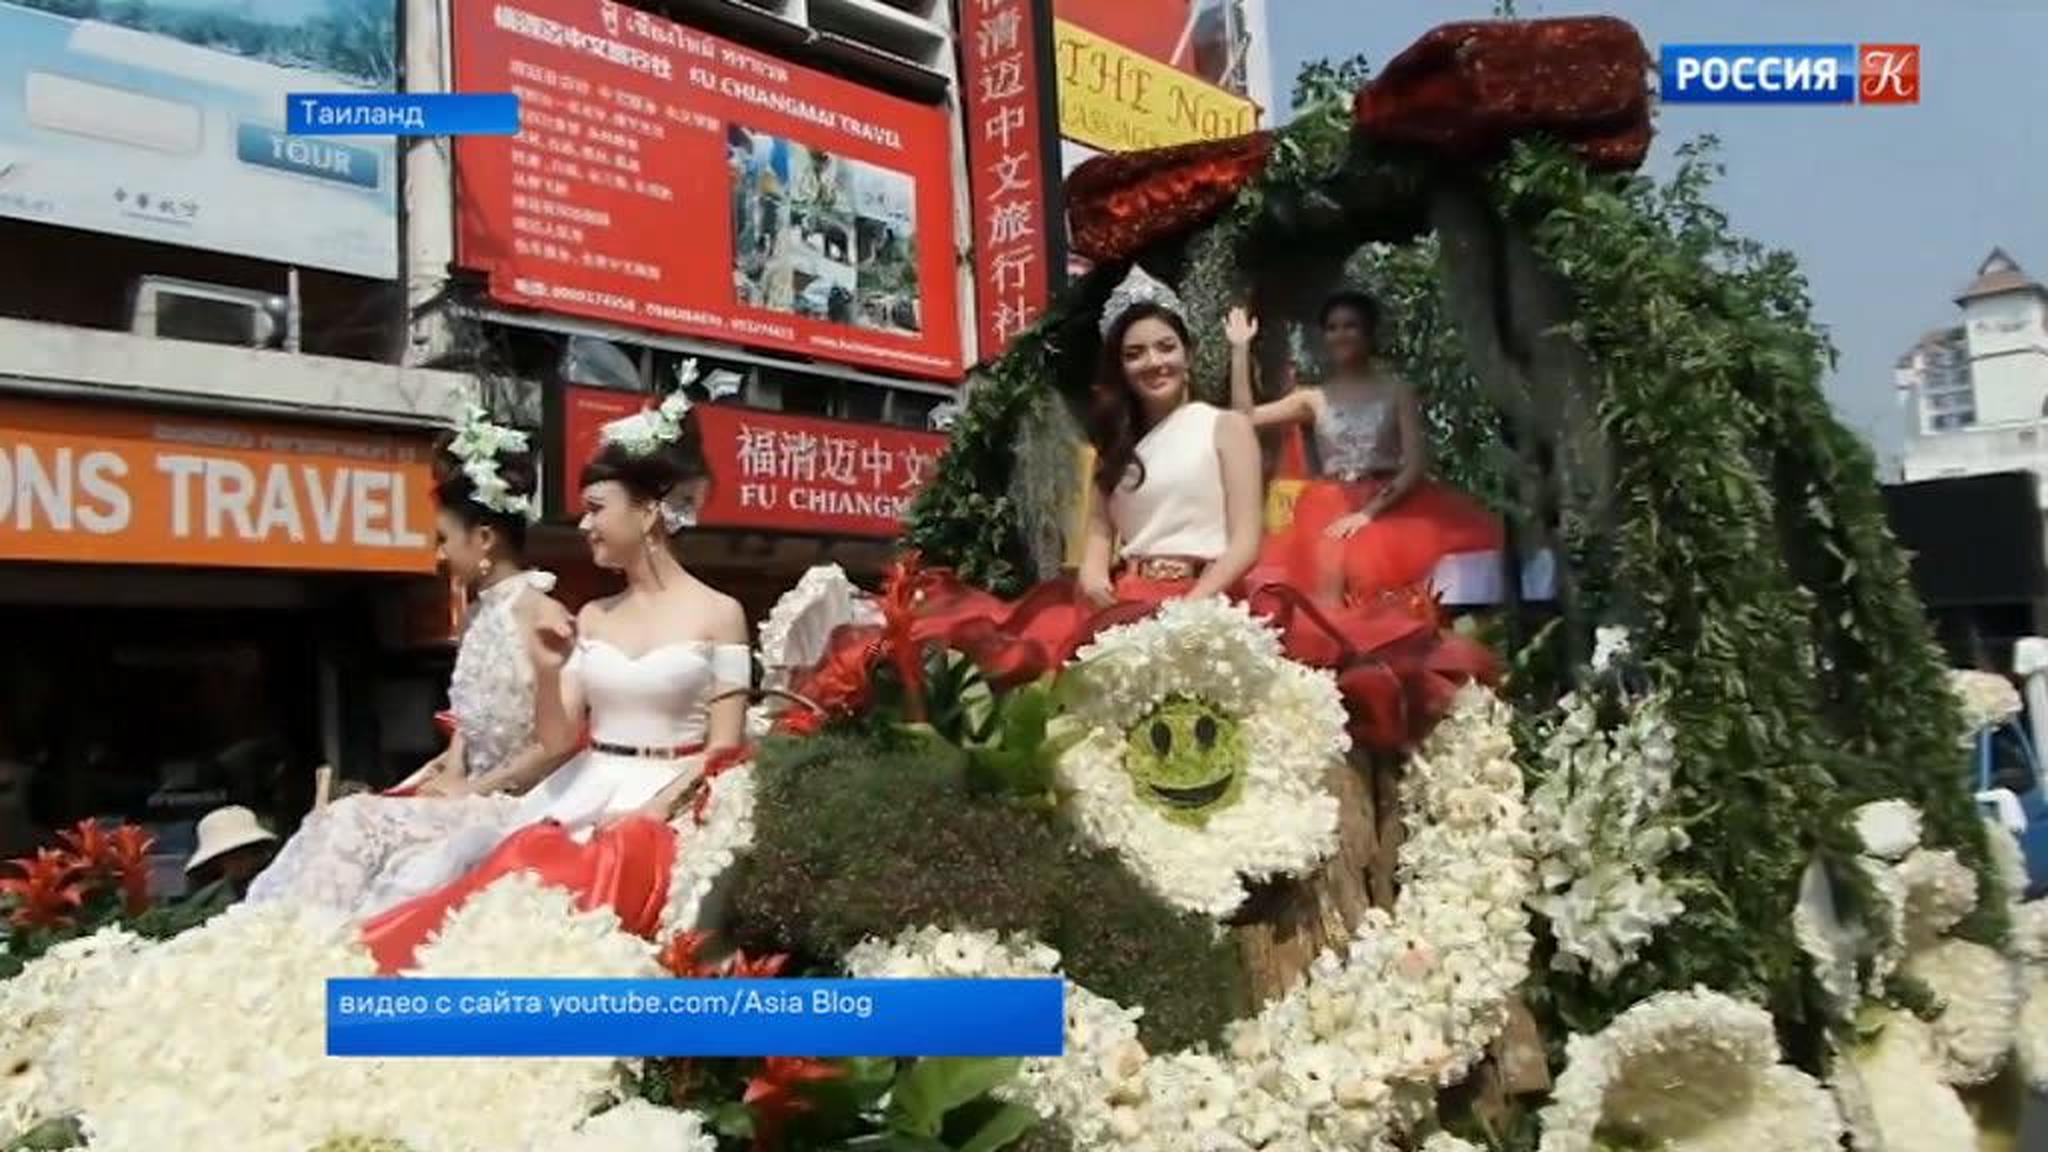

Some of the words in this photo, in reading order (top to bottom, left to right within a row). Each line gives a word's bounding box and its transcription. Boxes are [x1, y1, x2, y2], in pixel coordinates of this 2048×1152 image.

[1060, 37, 1152, 114] THE
[271, 136, 350, 175] TOUR
[736, 421, 945, 490] 福清迈中文
[155, 454, 428, 549] TRAVEL
[740, 484, 778, 509] FU
[788, 488, 913, 518] CHIANGM
